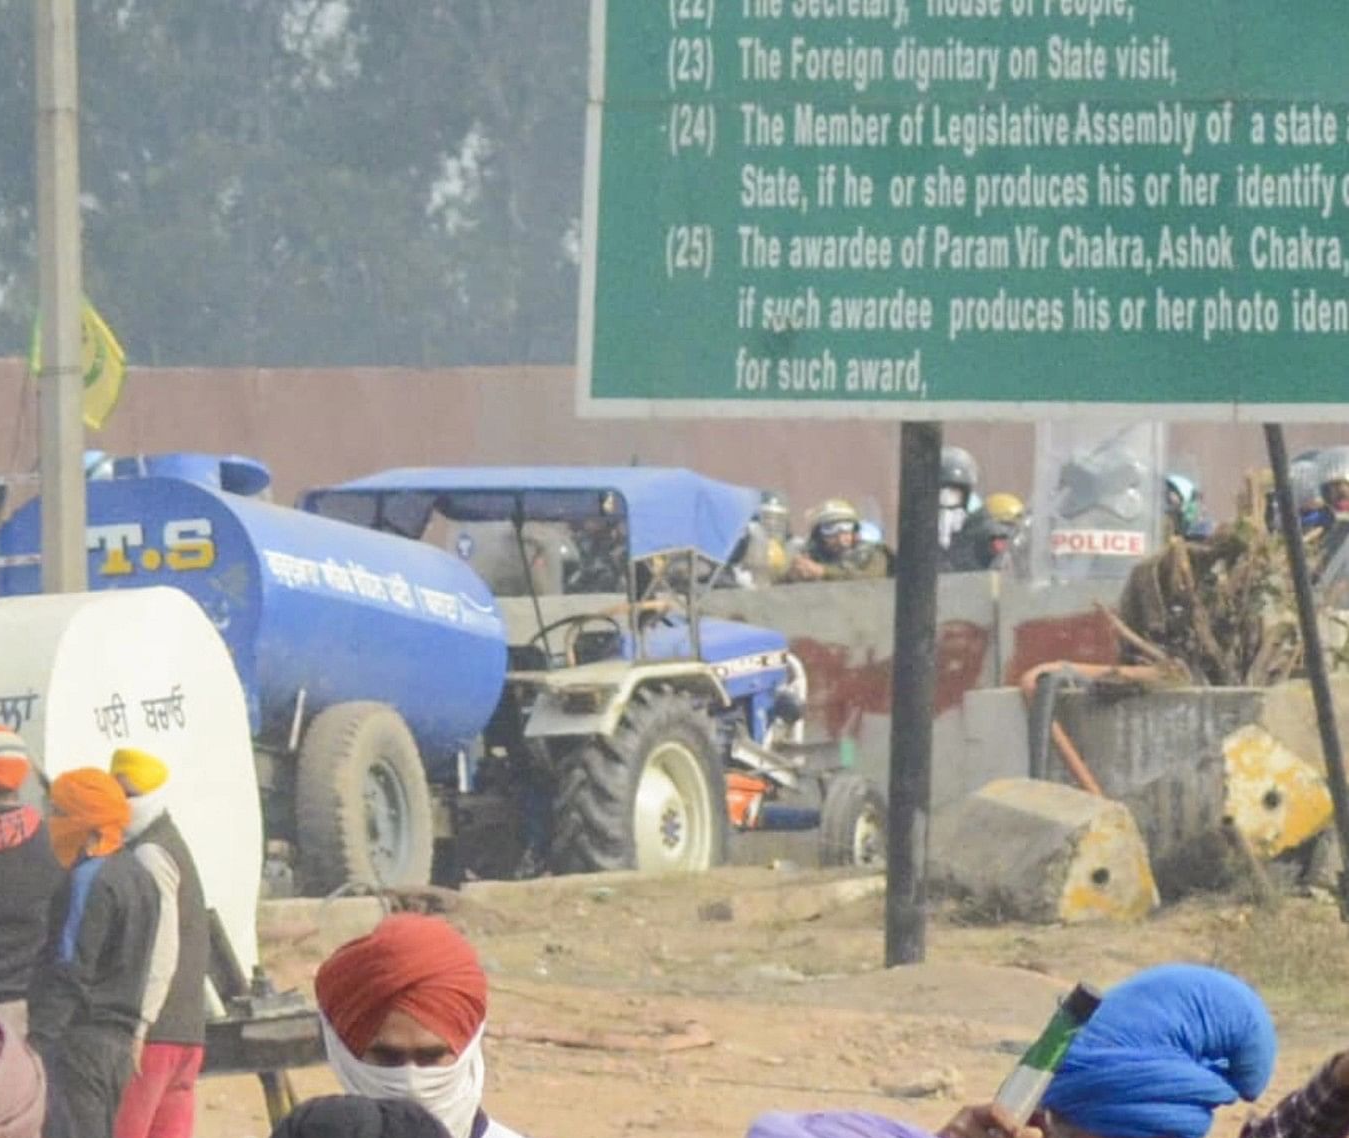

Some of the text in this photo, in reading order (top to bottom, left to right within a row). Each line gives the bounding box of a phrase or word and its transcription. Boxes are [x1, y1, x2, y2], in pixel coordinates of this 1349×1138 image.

[668, 34, 1177, 91] (23) The Foreign dignitary on State visit,
[669, 103, 715, 156] (24)
[741, 103, 785, 146] The
[795, 103, 890, 146] Member
[899, 103, 924, 147] of
[934, 101, 1069, 157] Legislative
[1076, 101, 1196, 156] Assembly
[1206, 101, 1234, 145] of
[1251, 112, 1265, 145] a
[1274, 102, 1338, 145] state
[742, 163, 808, 213] State,
[817, 164, 836, 207] if
[845, 165, 873, 207] he
[890, 173, 916, 207] or
[924, 164, 966, 207] she
[975, 163, 1089, 218] produces
[1099, 163, 1135, 206] his
[1144, 173, 1172, 207] or
[1178, 163, 1220, 206] her
[1237, 163, 1335, 219] identify
[666, 224, 713, 278] (25)
[738, 226, 782, 268] The
[789, 226, 892, 269] awardee
[901, 226, 926, 269] of
[934, 225, 1009, 269] Param
[1015, 225, 1050, 268] Vir
[1058, 225, 1152, 276] Chakra,
[1157, 225, 1234, 269] Ashok
[738, 286, 756, 329] if
[762, 286, 820, 331] such
[829, 288, 933, 331] awardee
[950, 287, 1064, 341] produces
[1073, 287, 1111, 331] his
[1120, 297, 1146, 331] or
[1156, 287, 1197, 331] her
[1204, 287, 1279, 341] photo
[735, 347, 926, 399] for such award,
[1053, 534, 1141, 552] POLICE
